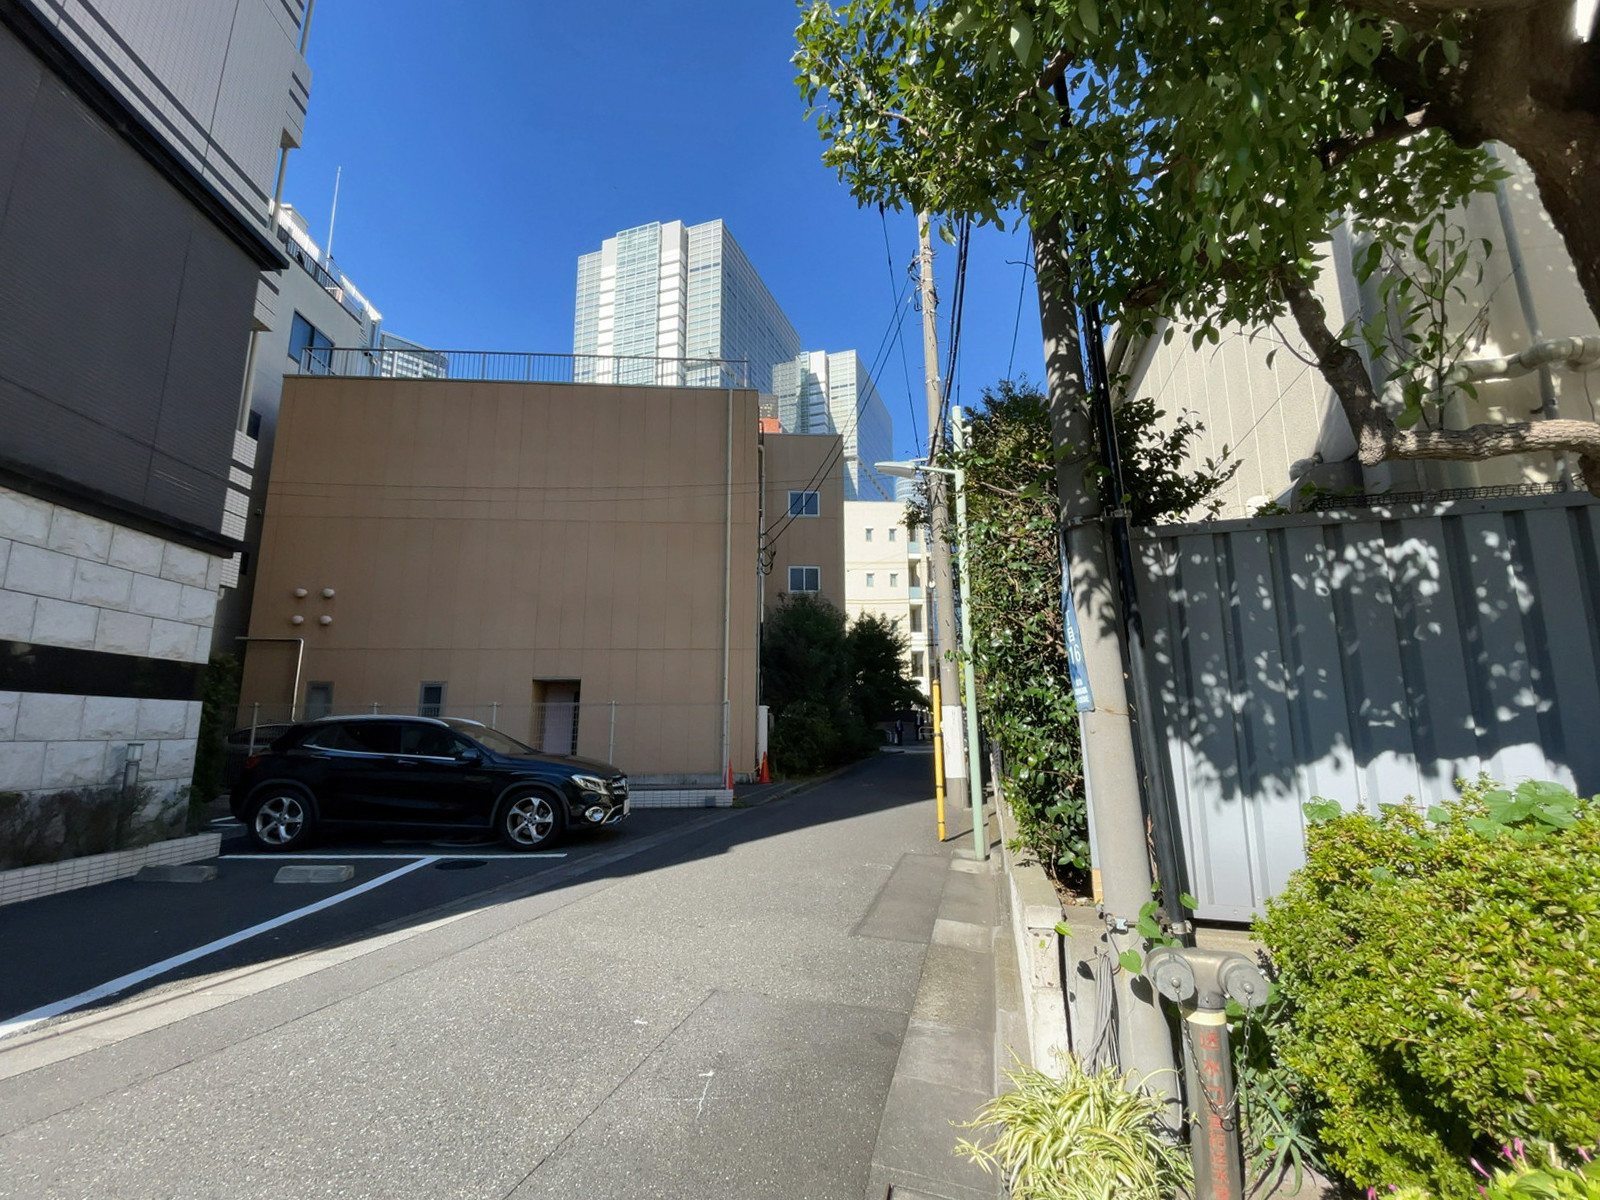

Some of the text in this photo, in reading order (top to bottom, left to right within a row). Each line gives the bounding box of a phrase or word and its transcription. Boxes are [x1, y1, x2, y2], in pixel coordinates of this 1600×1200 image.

[1069, 644, 1081, 664] 16
[1199, 1029, 1225, 1106] 送水口
